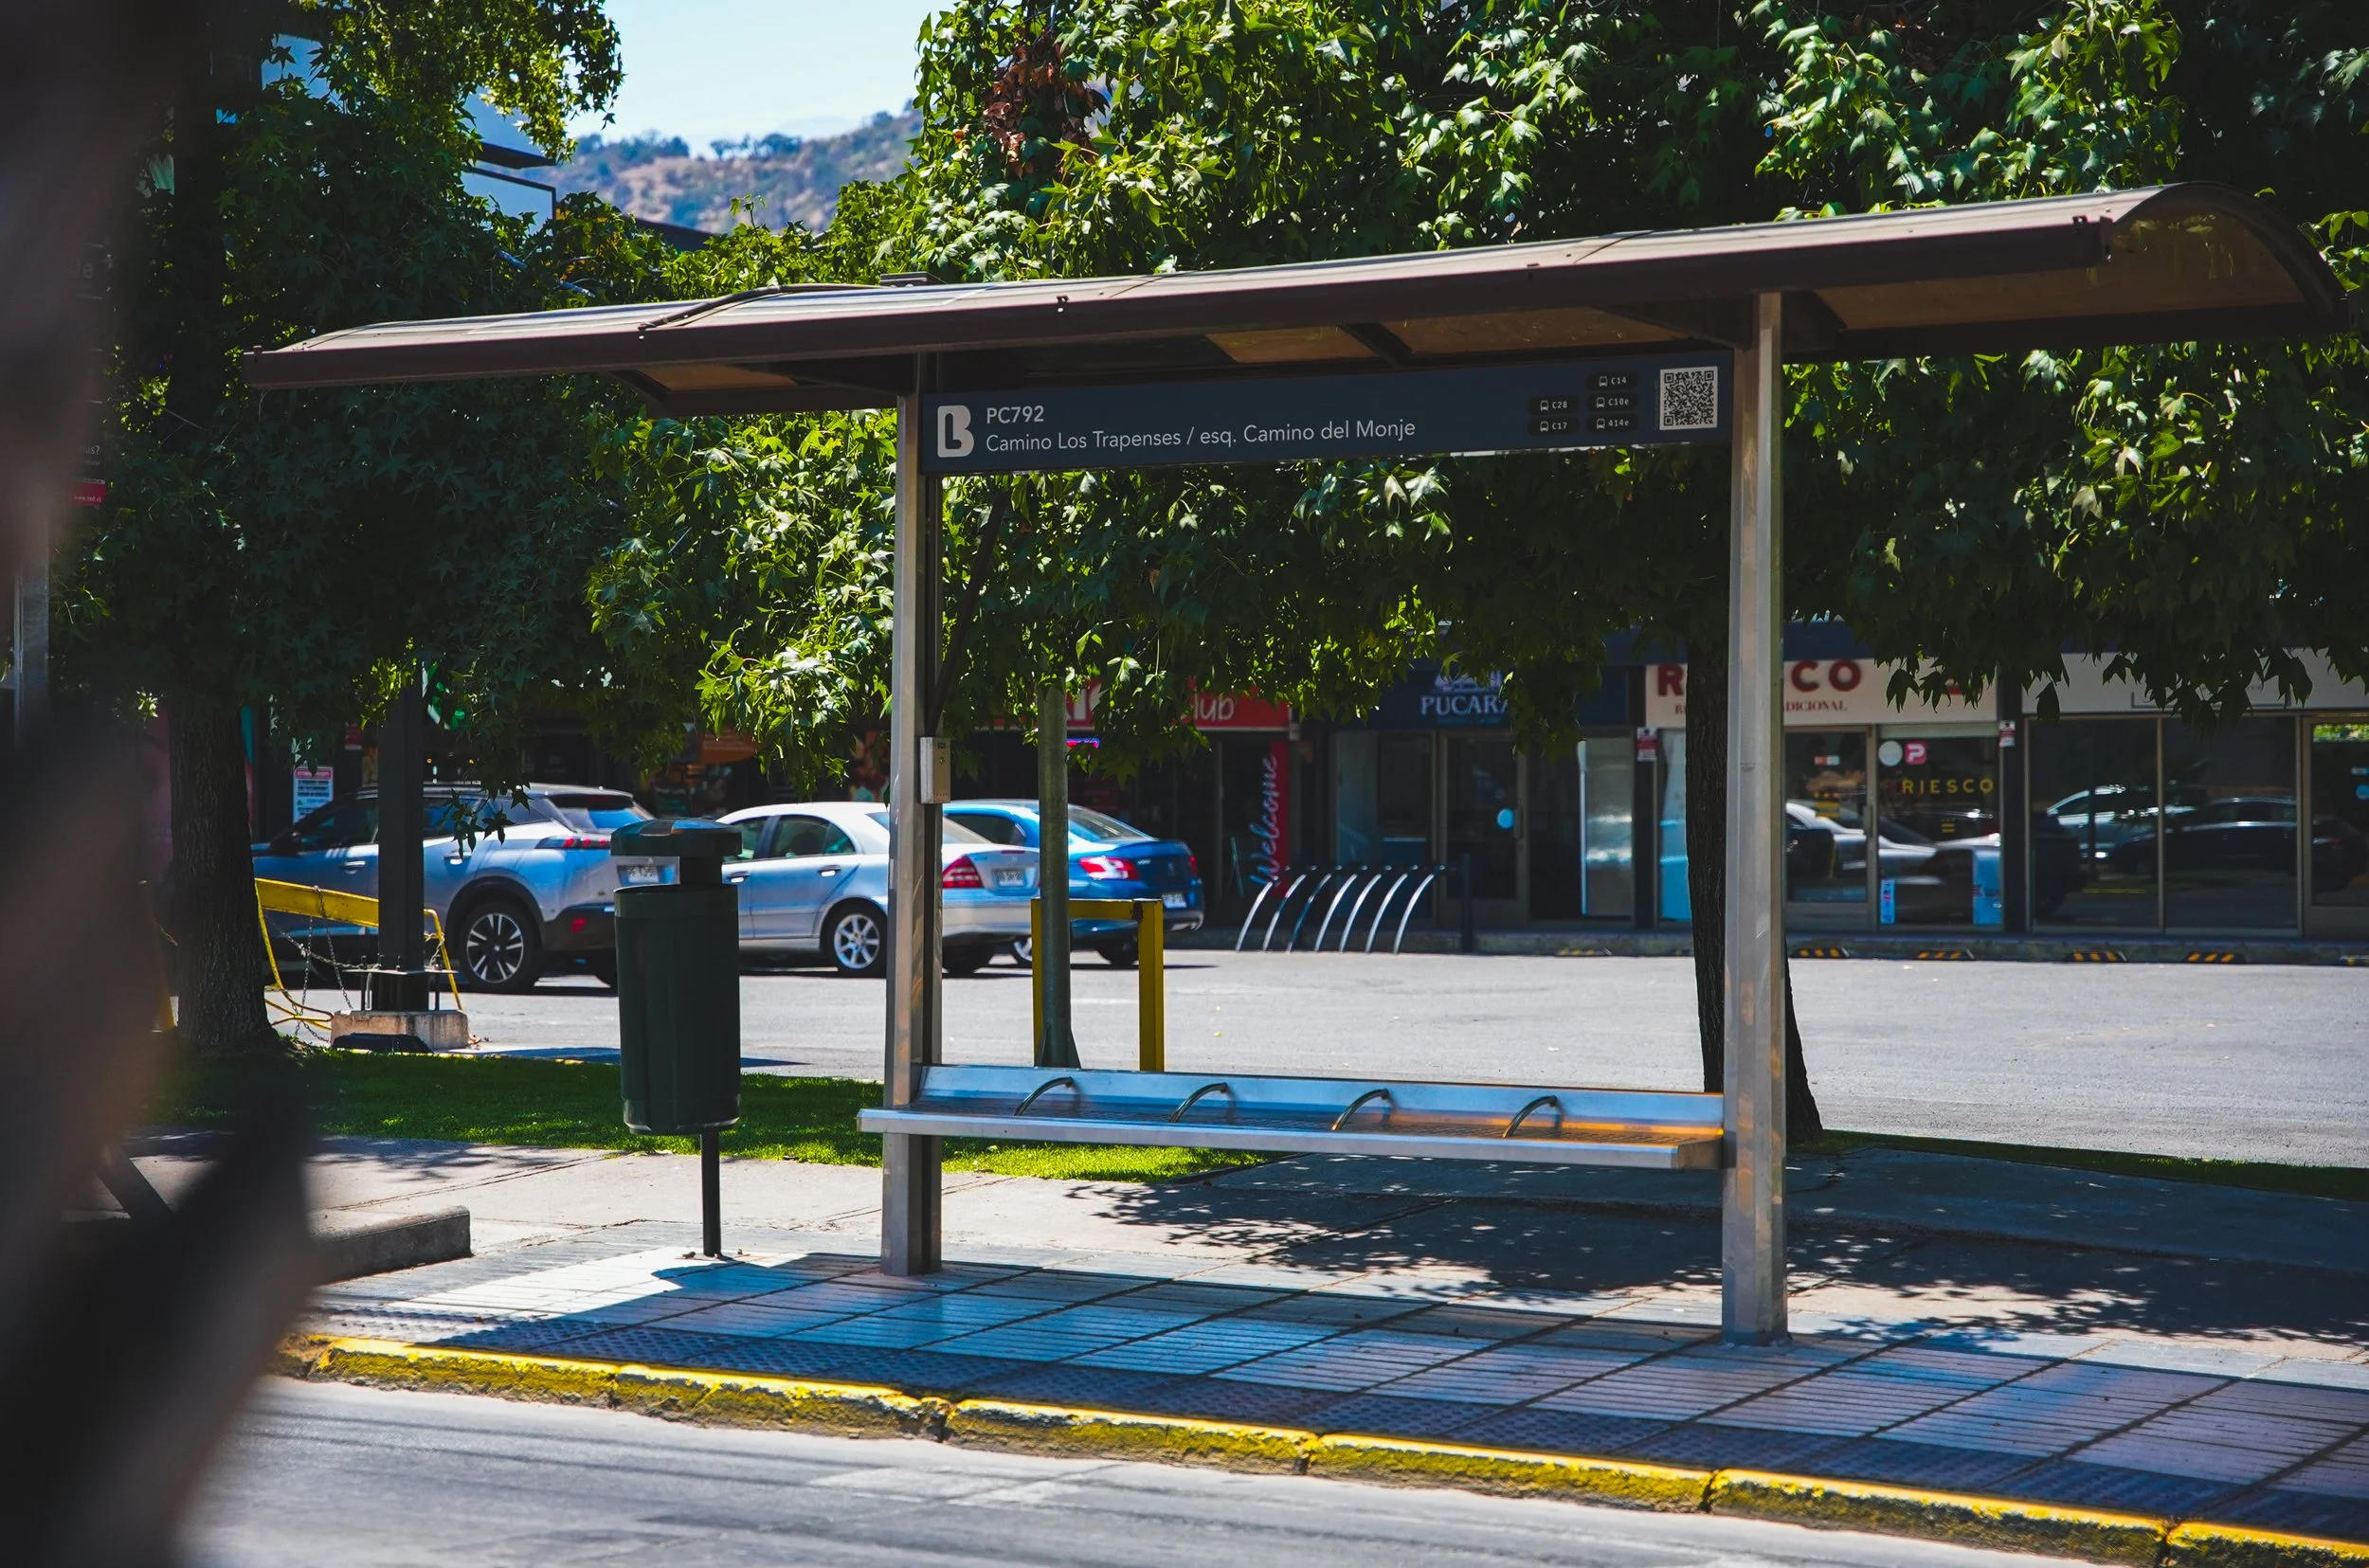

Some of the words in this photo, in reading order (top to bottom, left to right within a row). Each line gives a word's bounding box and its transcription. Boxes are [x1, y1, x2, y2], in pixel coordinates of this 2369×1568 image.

[1610, 376, 1627, 386] C14
[1551, 401, 1567, 409] C28
[1608, 397, 1630, 406] C10e
[986, 405, 1044, 424] PC792
[1551, 422, 1567, 430] C17
[1608, 419, 1630, 427] 414e
[986, 433, 1052, 452] Camino
[1058, 431, 1087, 449] Los
[1092, 430, 1182, 452] Trapenses
[1200, 430, 1237, 448] esq.
[1243, 424, 1314, 442] Camino
[1320, 420, 1349, 440] del
[1356, 418, 1416, 442] Monje
[1193, 693, 1236, 722] lub
[1902, 778, 1995, 796] RIESCO
